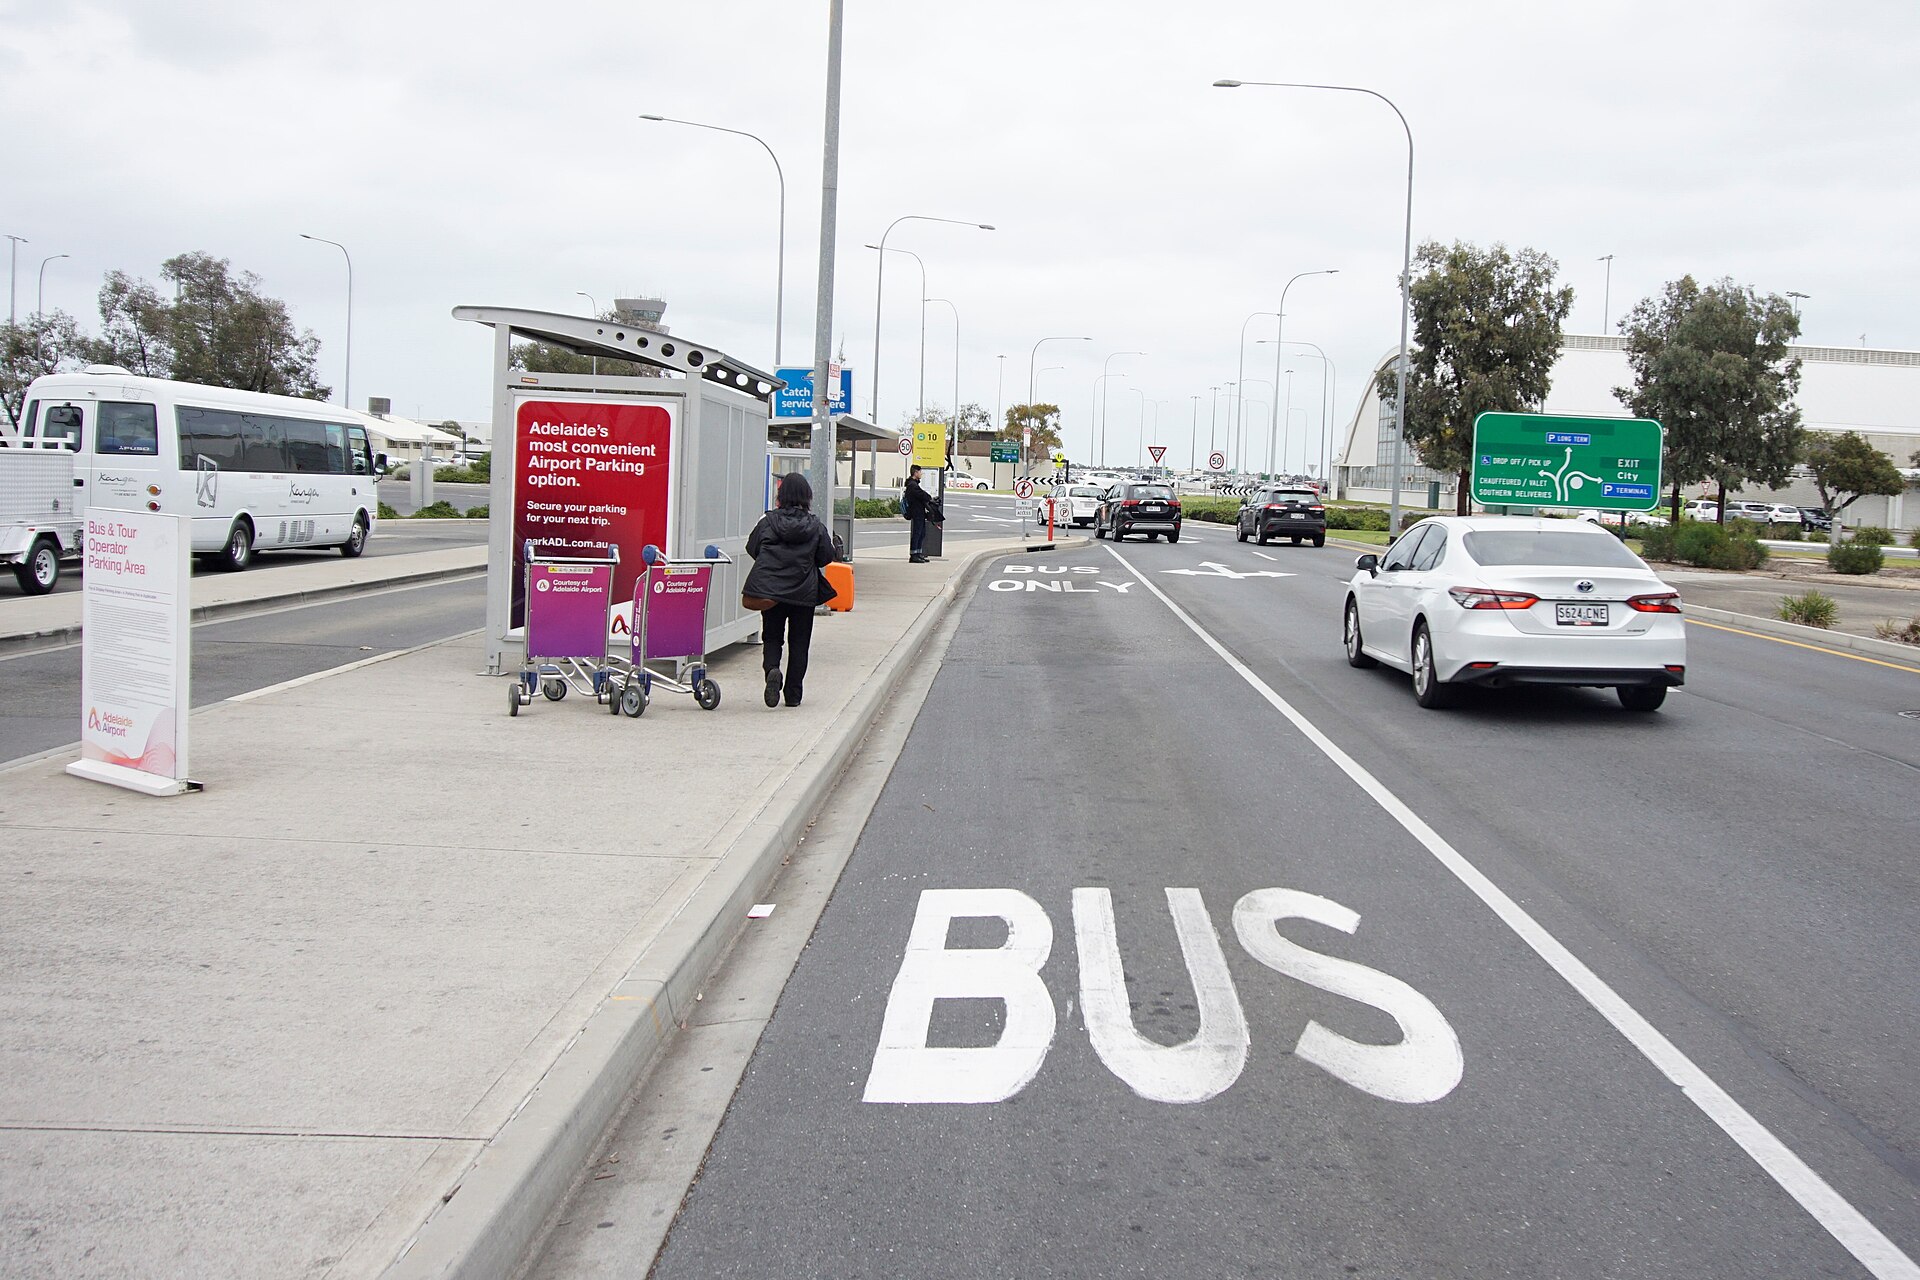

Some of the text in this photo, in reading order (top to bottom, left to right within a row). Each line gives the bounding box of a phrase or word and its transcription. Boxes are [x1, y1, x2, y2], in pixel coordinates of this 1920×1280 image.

[782, 387, 811, 397] Catch
[782, 399, 846, 409] servic ere
[529, 421, 609, 437] Adelaide's
[927, 433, 938, 441] 10
[1548, 434, 1556, 442] P
[529, 440, 656, 457] most convenient
[901, 443, 910, 451] 50
[528, 455, 645, 476] Airport Parking
[1212, 457, 1222, 465] 50
[1543, 459, 1551, 467] UP
[1617, 458, 1640, 468] EXIT
[528, 473, 581, 488] option.
[1479, 477, 1521, 486] CHAUFFEURED
[1617, 471, 1639, 481] City
[1478, 488, 1552, 499] SOUTHERN DELIVERIES
[1603, 485, 1648, 495] P TERMINAL
[527, 501, 627, 515] Secure your parking
[526, 513, 611, 527] for your next trip.
[88, 520, 137, 539] Bus & Tour
[88, 537, 128, 555] Operator
[88, 555, 146, 575] Parking Area
[1003, 564, 1101, 574] BUS
[552, 579, 580, 587] Courtesy
[988, 579, 1136, 593] ONLY
[102, 711, 133, 727] Adelaide
[102, 722, 126, 737] Airport
[862, 887, 1465, 1104] BUS
